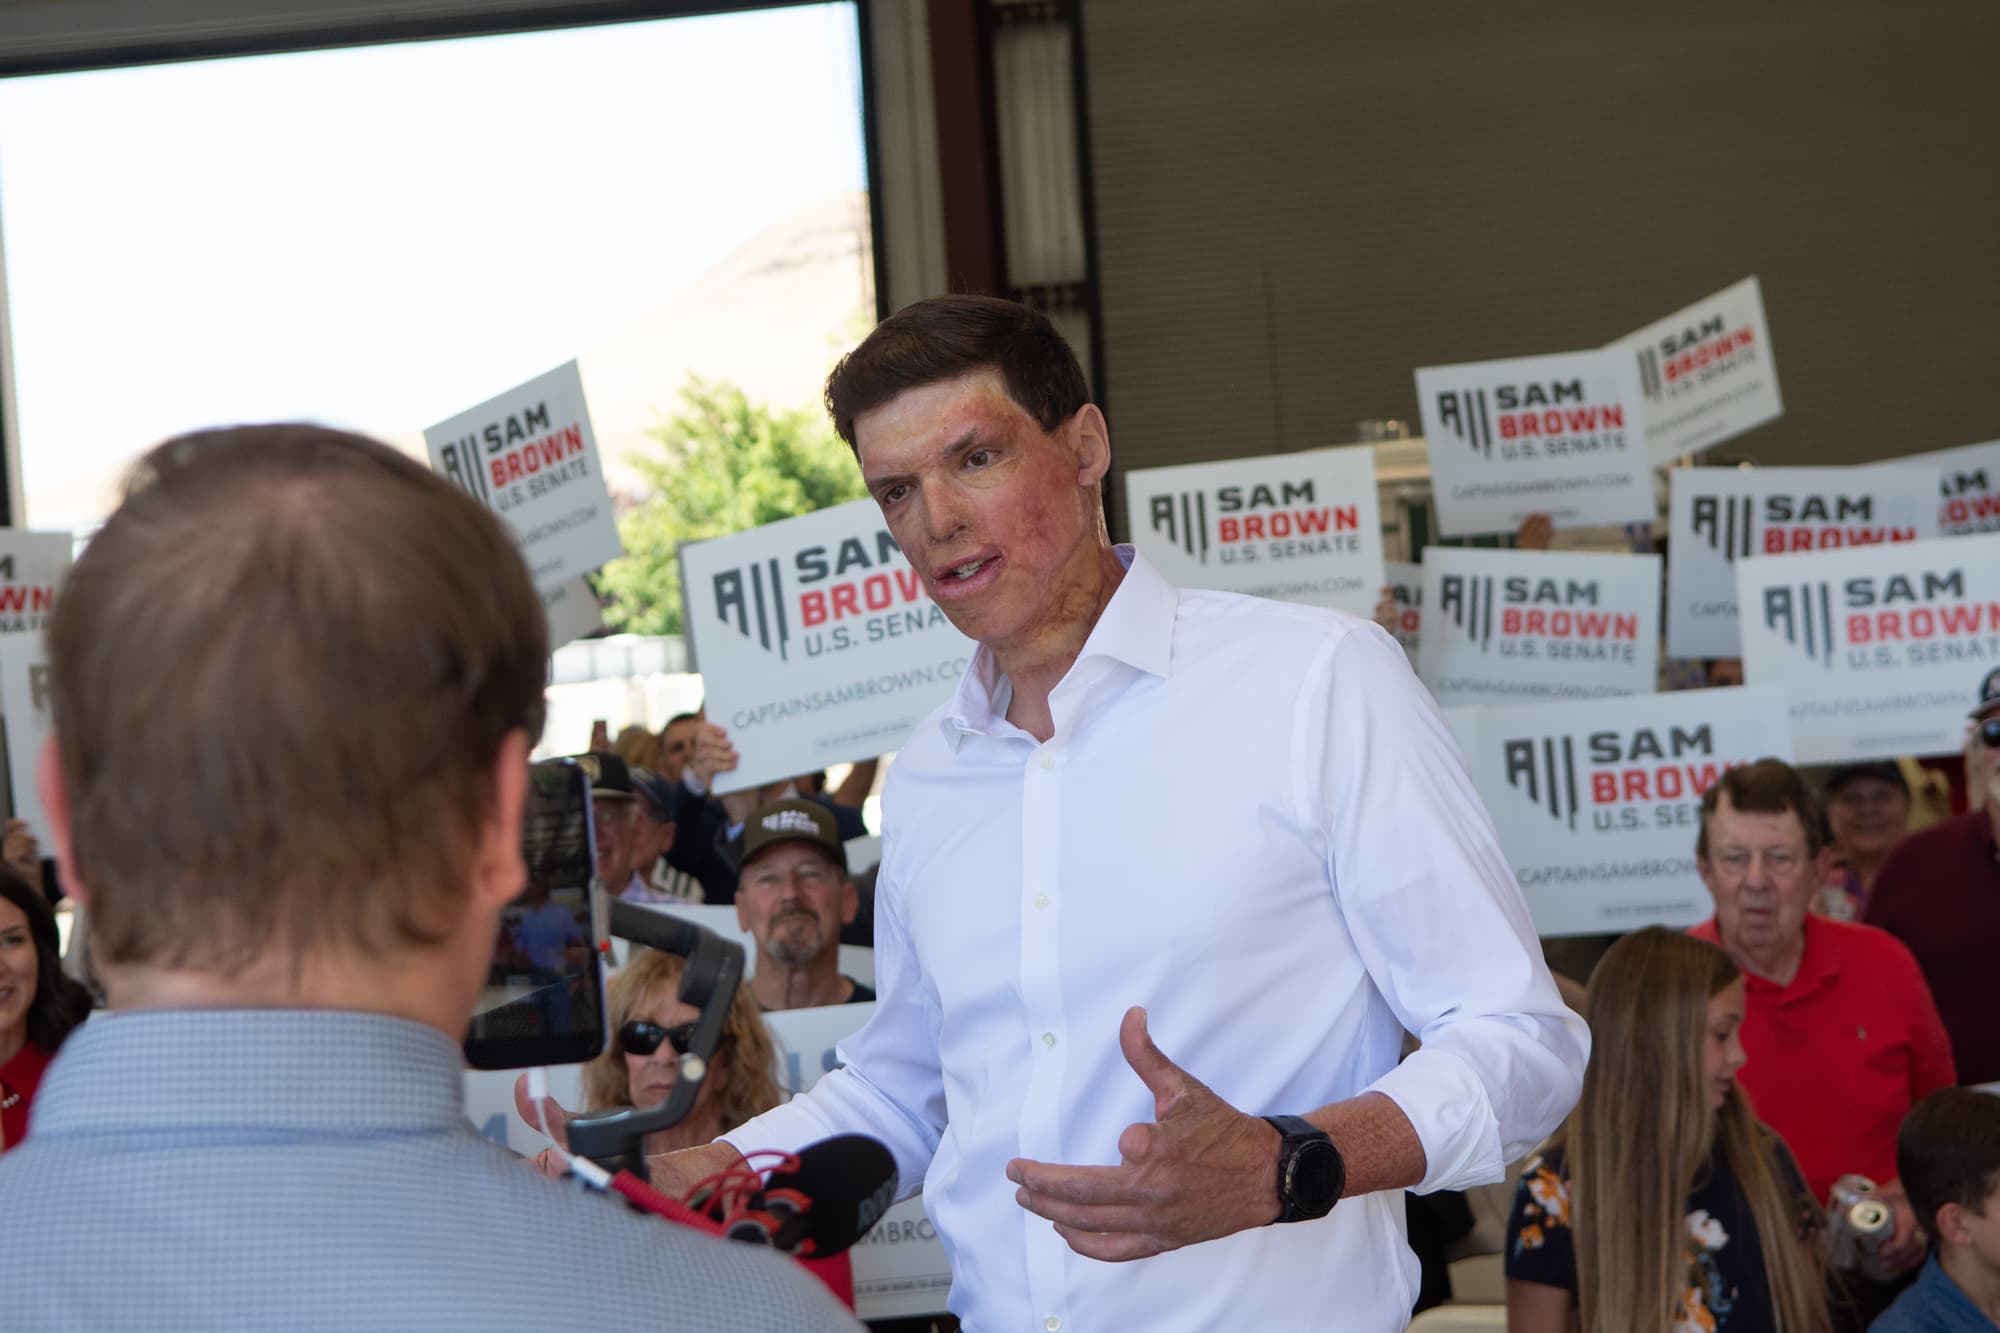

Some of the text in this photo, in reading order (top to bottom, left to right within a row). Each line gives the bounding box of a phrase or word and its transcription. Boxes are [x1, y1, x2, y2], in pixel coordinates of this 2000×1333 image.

[1660, 313, 1724, 357] SAM
[1664, 324, 1754, 381] BROWN
[1495, 378, 1583, 410] SAM
[482, 400, 550, 453] SAM
[1499, 404, 1625, 440] BROWN
[489, 422, 584, 489] BROWN
[1501, 431, 1627, 459] U.S. SENATE
[497, 456, 589, 512] U.S. SENATE
[1217, 479, 1315, 512] SAM
[1219, 504, 1359, 543] BROWN
[1765, 496, 1872, 522] SAM
[1220, 534, 1360, 564] U.S. SENATE
[799, 568, 930, 628] BROW
[1504, 577, 1598, 605] SAM
[1845, 569, 1964, 607] SAM
[804, 604, 948, 657] U.S. SENA
[1502, 608, 1638, 640] BROWN
[1500, 640, 1635, 664] U.S. SENATE
[1847, 637, 2000, 670] U.S. SENAT
[732, 658, 968, 730] CAPTAINSAMBROWN.CO
[1589, 724, 1713, 763] SAM
[1591, 760, 1748, 804] BROW
[1594, 807, 1647, 832] U.S.
[1517, 857, 1696, 885] CAPTAINSAMBROW
